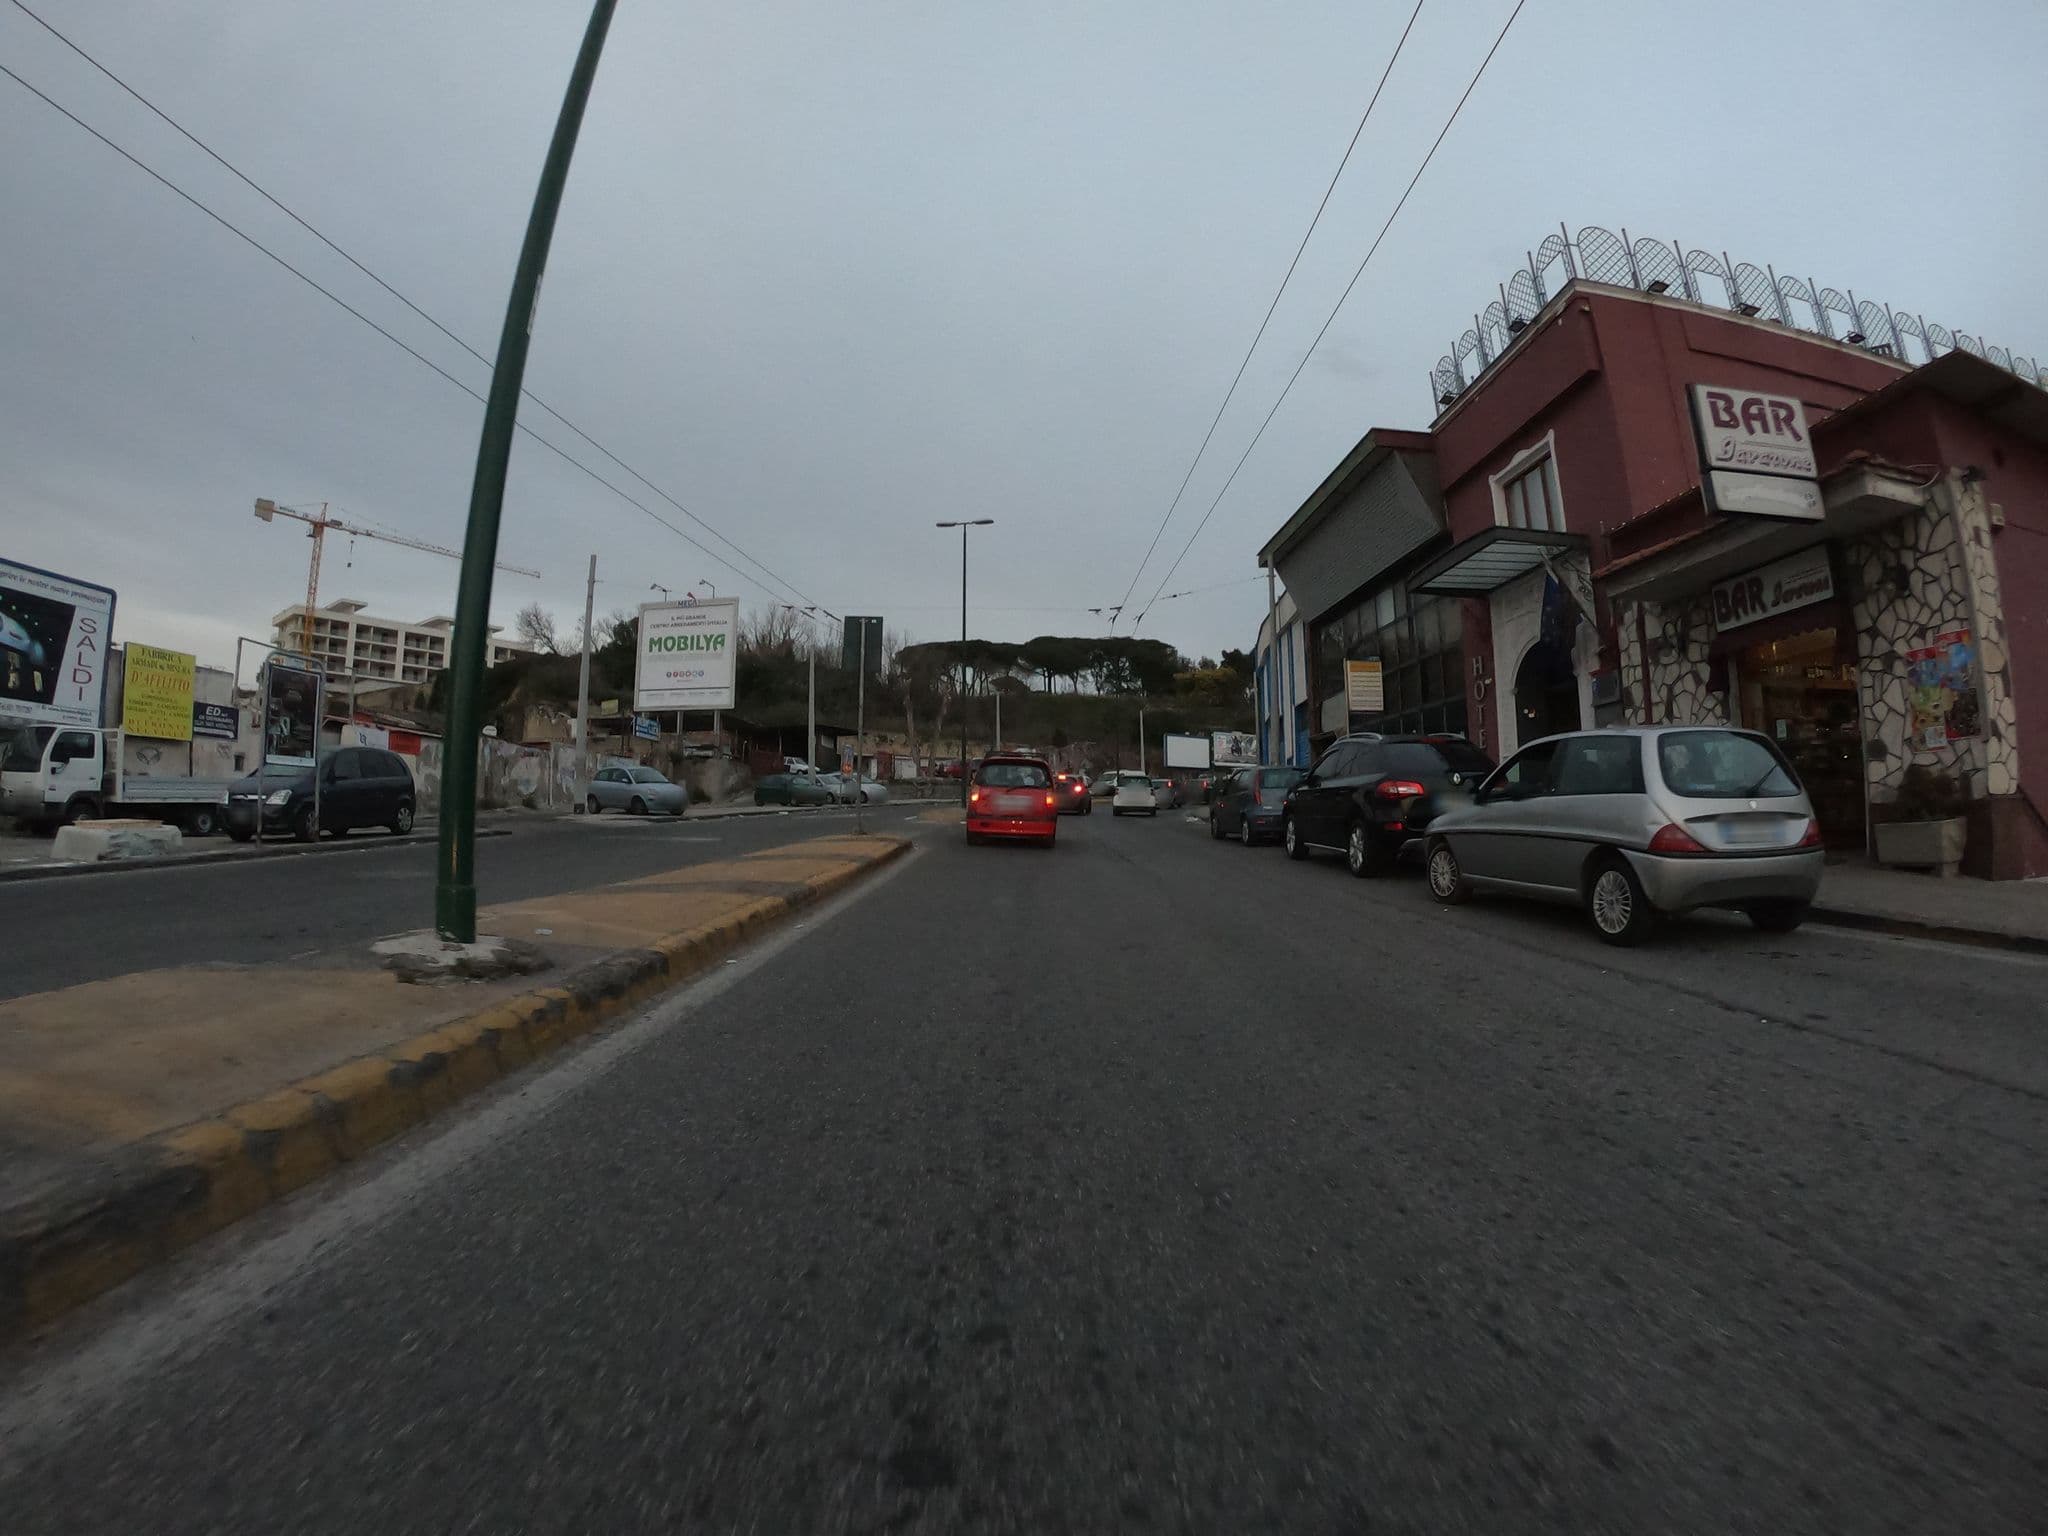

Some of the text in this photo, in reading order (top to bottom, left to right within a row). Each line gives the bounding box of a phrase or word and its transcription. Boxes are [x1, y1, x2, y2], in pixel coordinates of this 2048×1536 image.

[1706, 391, 1802, 442] BAR
[1713, 575, 1768, 623] BAR
[72, 616, 97, 702] SALDI
[648, 633, 726, 653] MOBILYA
[206, 706, 221, 717] ED
[1471, 655, 1489, 750] HOTE
